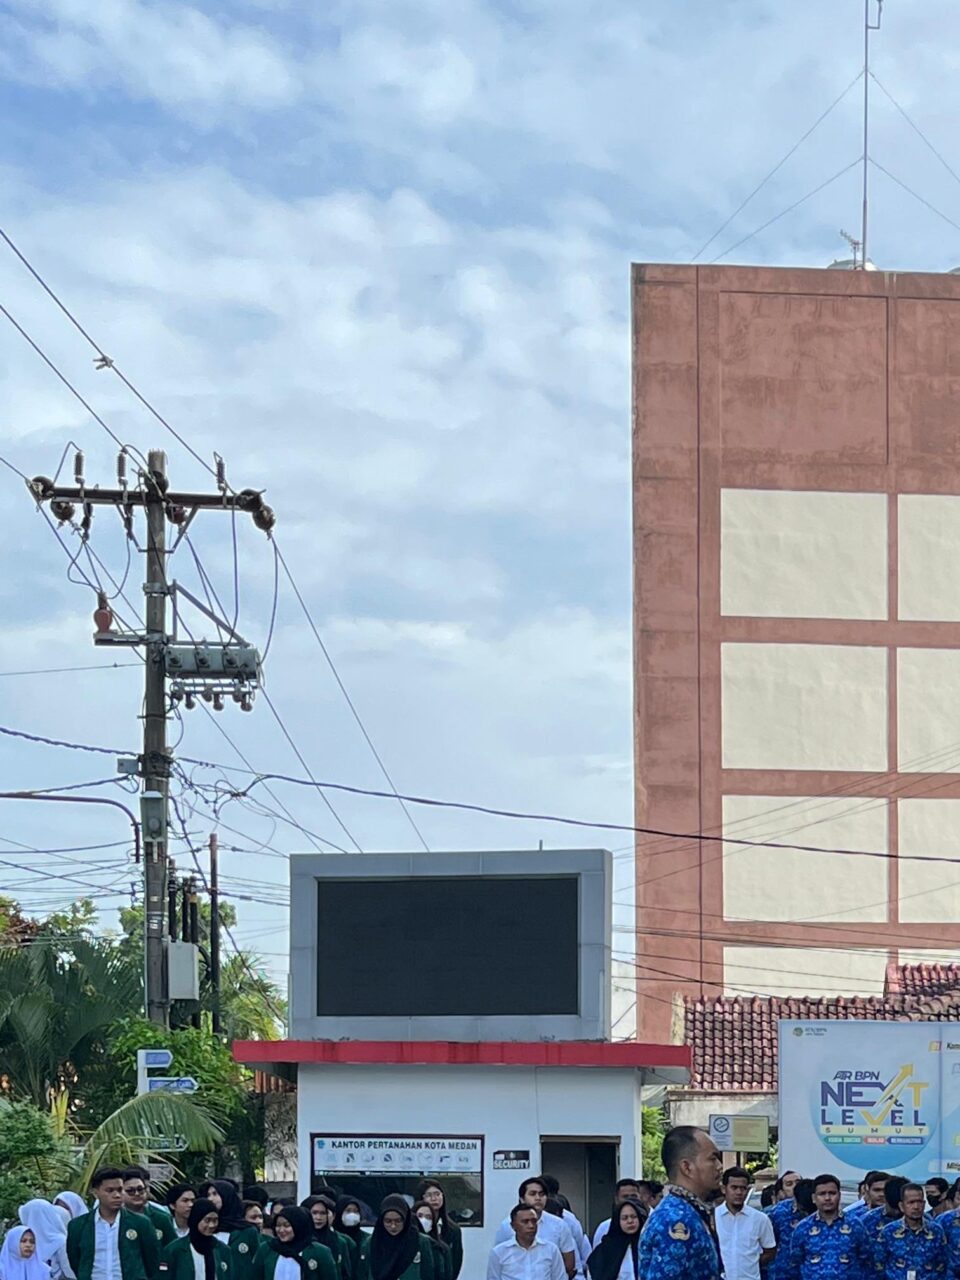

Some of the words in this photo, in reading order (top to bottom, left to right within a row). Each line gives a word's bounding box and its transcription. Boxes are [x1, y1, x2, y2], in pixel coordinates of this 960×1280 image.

[833, 1070, 853, 1080] ATR
[854, 1070, 881, 1080] BPN
[821, 1074, 929, 1108] NEXT
[821, 1109, 926, 1126] LEVEL
[332, 1140, 365, 1149] KANTOR
[367, 1141, 422, 1149] PERTANAHAN
[424, 1141, 446, 1150] KOTA
[448, 1142, 477, 1150] MEDAN
[493, 1160, 530, 1169] SECURITY
